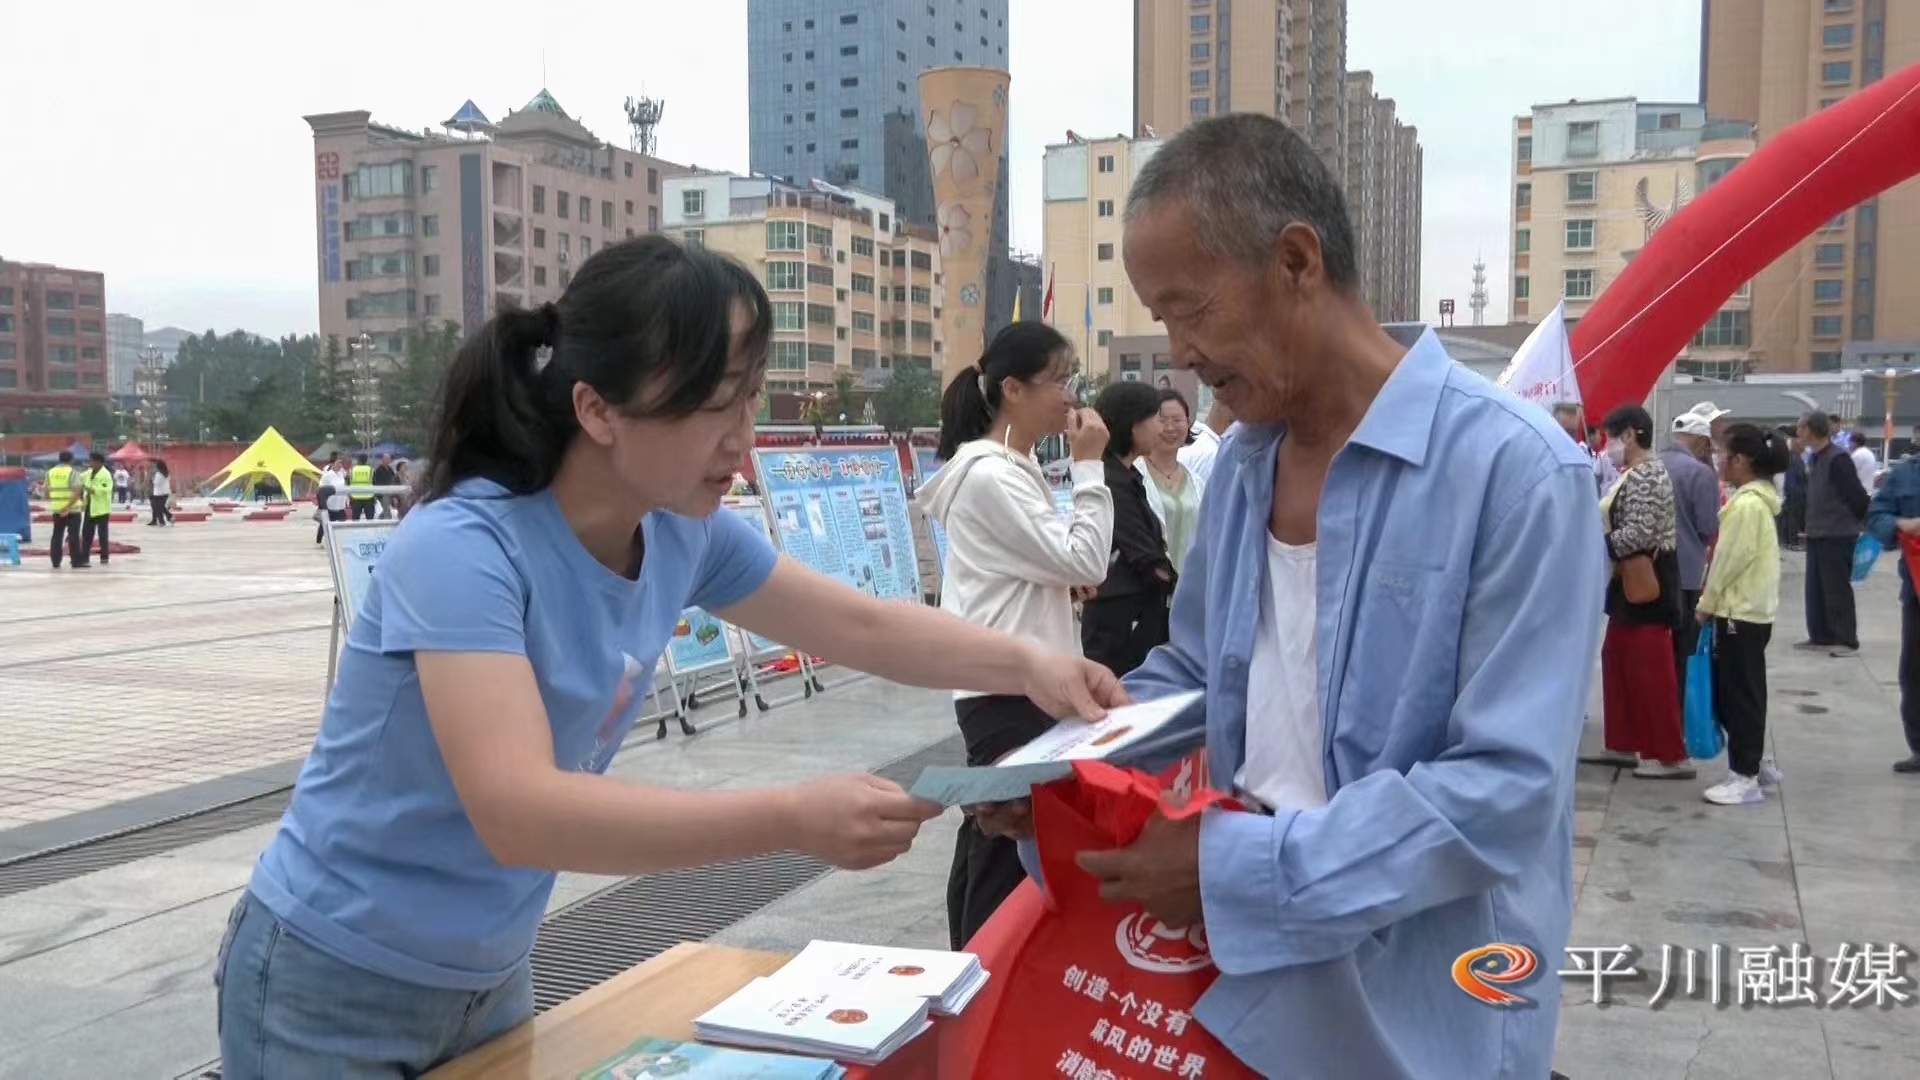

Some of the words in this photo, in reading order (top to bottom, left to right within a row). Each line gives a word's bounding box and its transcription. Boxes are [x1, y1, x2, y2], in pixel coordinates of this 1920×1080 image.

[1063, 964, 1192, 1036] 创造一个没有
[1090, 1017, 1206, 1079] 麻风的世界
